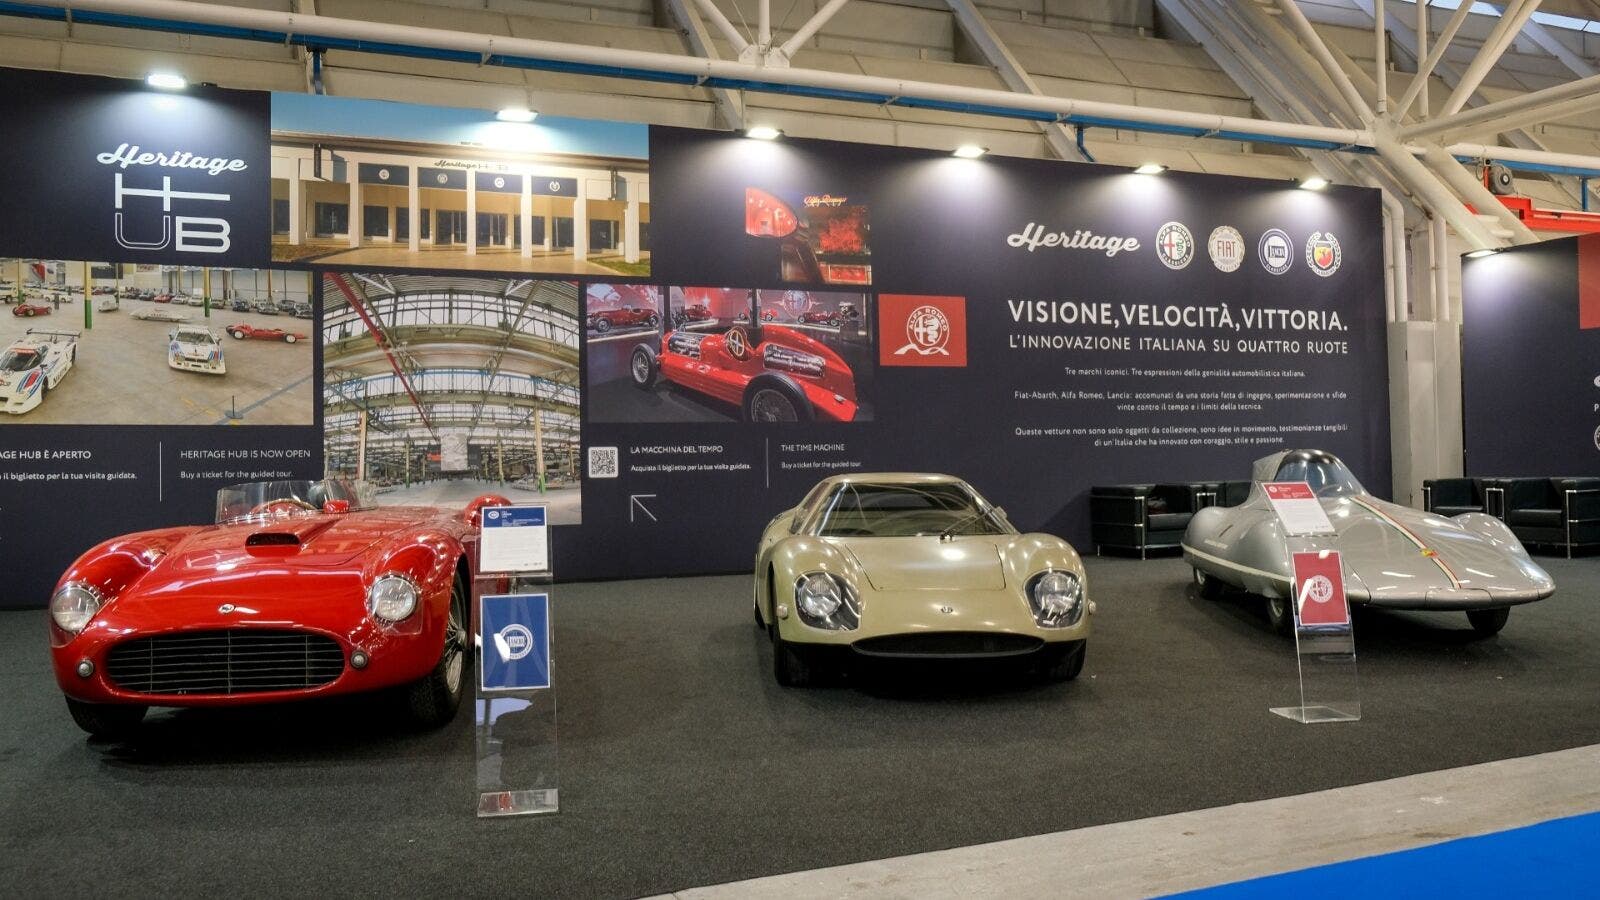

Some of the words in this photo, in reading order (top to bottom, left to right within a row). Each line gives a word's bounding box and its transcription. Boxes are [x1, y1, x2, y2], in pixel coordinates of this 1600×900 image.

[96, 143, 248, 176] Heritage
[1006, 222, 1141, 257] Heritage
[1217, 240, 1236, 258] FIAT
[909, 311, 922, 330] ALFA
[926, 308, 948, 331] ROMEO
[1010, 334, 1130, 350] L'INNOVAZIONE
[1140, 337, 1206, 351] ITALIANA
[1214, 340, 1230, 351] SU
[1237, 340, 1300, 354] QUATTRO
[1307, 341, 1348, 354] RUOTE
[1202, 370, 1230, 378] genialità
[1014, 391, 1058, 400] Fiat-Abarth,
[1247, 392, 1273, 400] ingegno,
[1015, 427, 1041, 436] Queste
[1126, 427, 1149, 436] oggetti
[1324, 424, 1348, 432] tangibili
[44, 450, 50, 458] È
[662, 464, 686, 472] biglietto
[11, 472, 44, 481] biglietto
[107, 472, 137, 480] guidata.
[181, 471, 194, 479] Buy
[251, 471, 274, 479] guided
